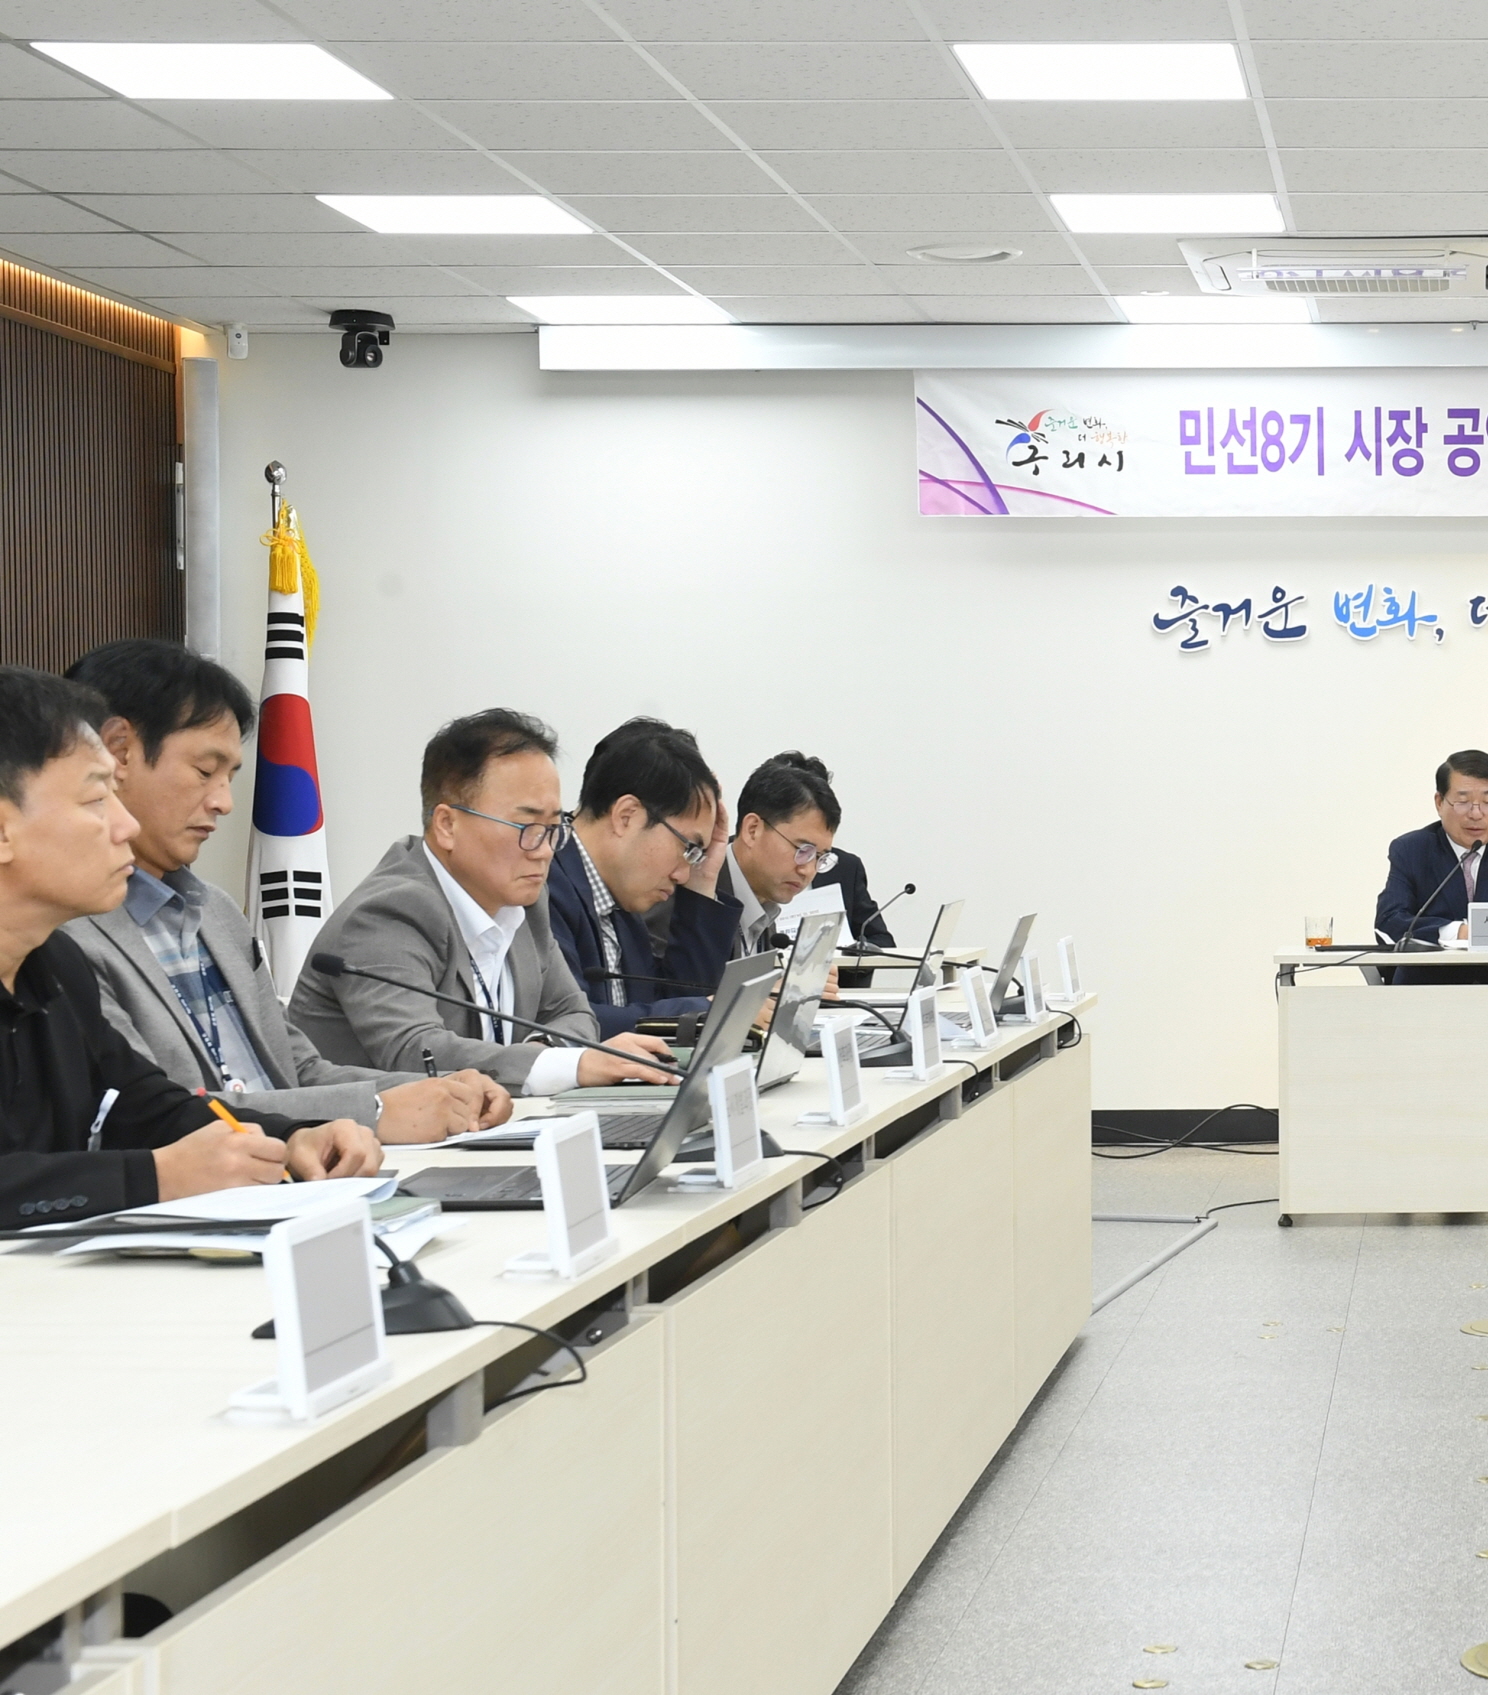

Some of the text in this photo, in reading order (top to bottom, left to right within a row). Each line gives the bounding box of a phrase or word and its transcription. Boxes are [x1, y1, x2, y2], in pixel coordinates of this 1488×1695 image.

[1044, 416, 1079, 432] 즐거운
[1077, 431, 1128, 448] 더 행복한
[1180, 407, 1325, 476] 민선8기
[1345, 407, 1428, 477] 시장
[1011, 444, 1124, 477] 구리시
[1153, 585, 1307, 649] 즐거운
[1333, 584, 1444, 642] 변화,
